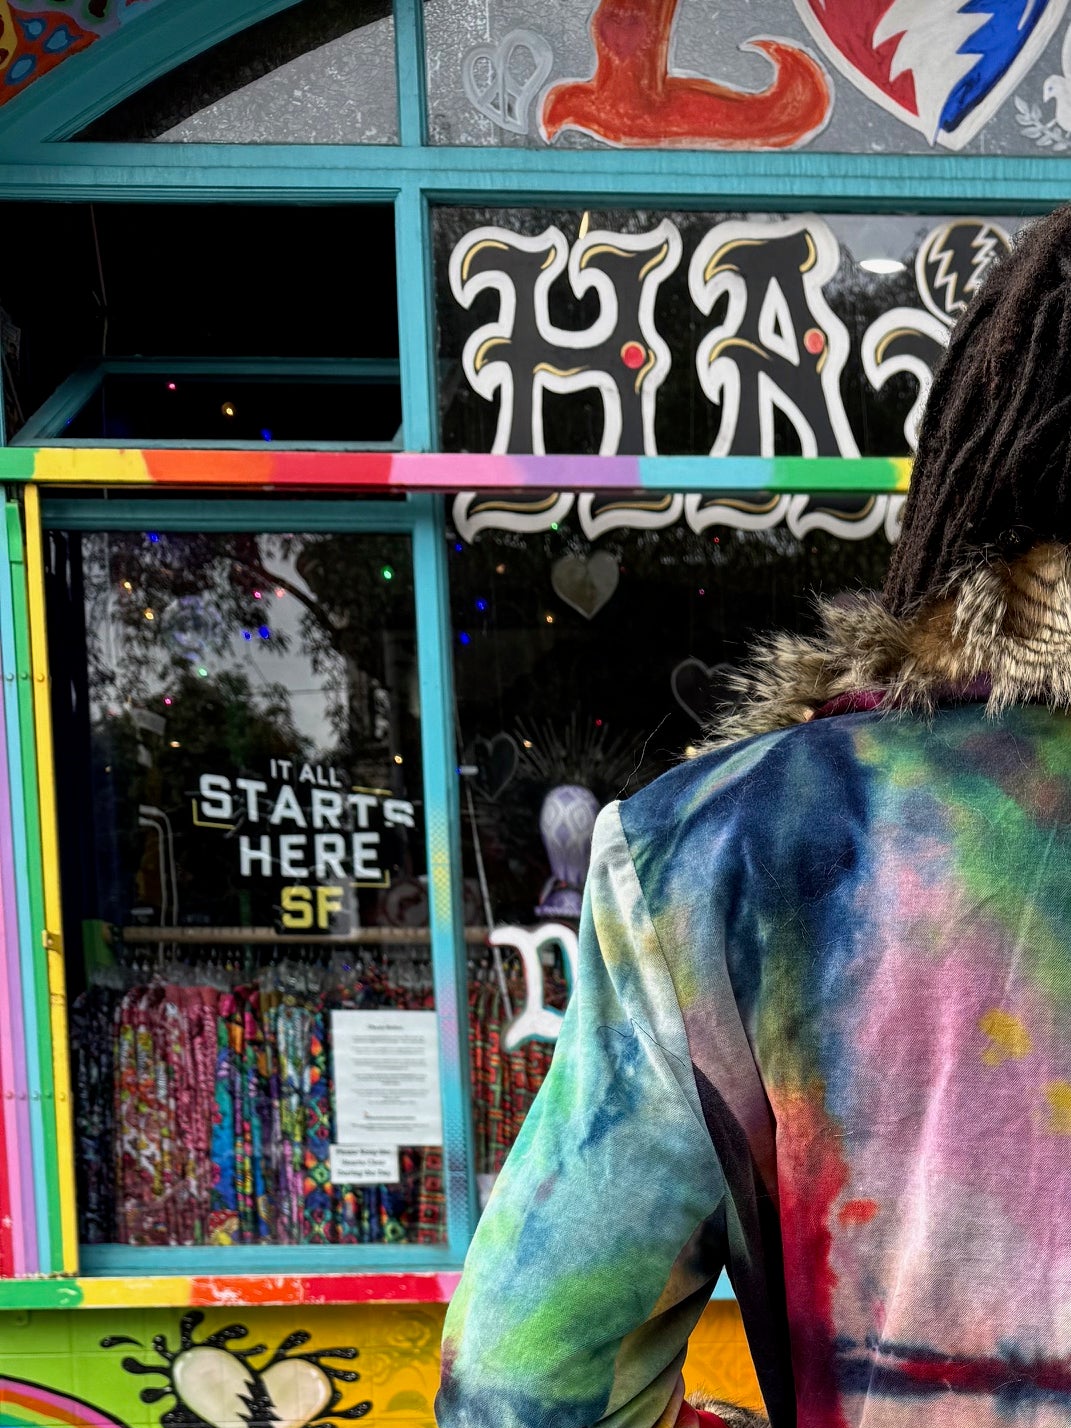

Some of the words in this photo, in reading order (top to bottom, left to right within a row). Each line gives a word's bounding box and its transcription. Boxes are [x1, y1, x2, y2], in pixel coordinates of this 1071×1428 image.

[270, 758, 293, 779] IT
[299, 763, 343, 788] ALL
[199, 773, 415, 829] STARTS
[239, 832, 382, 879] HERE
[280, 885, 344, 929] SF
